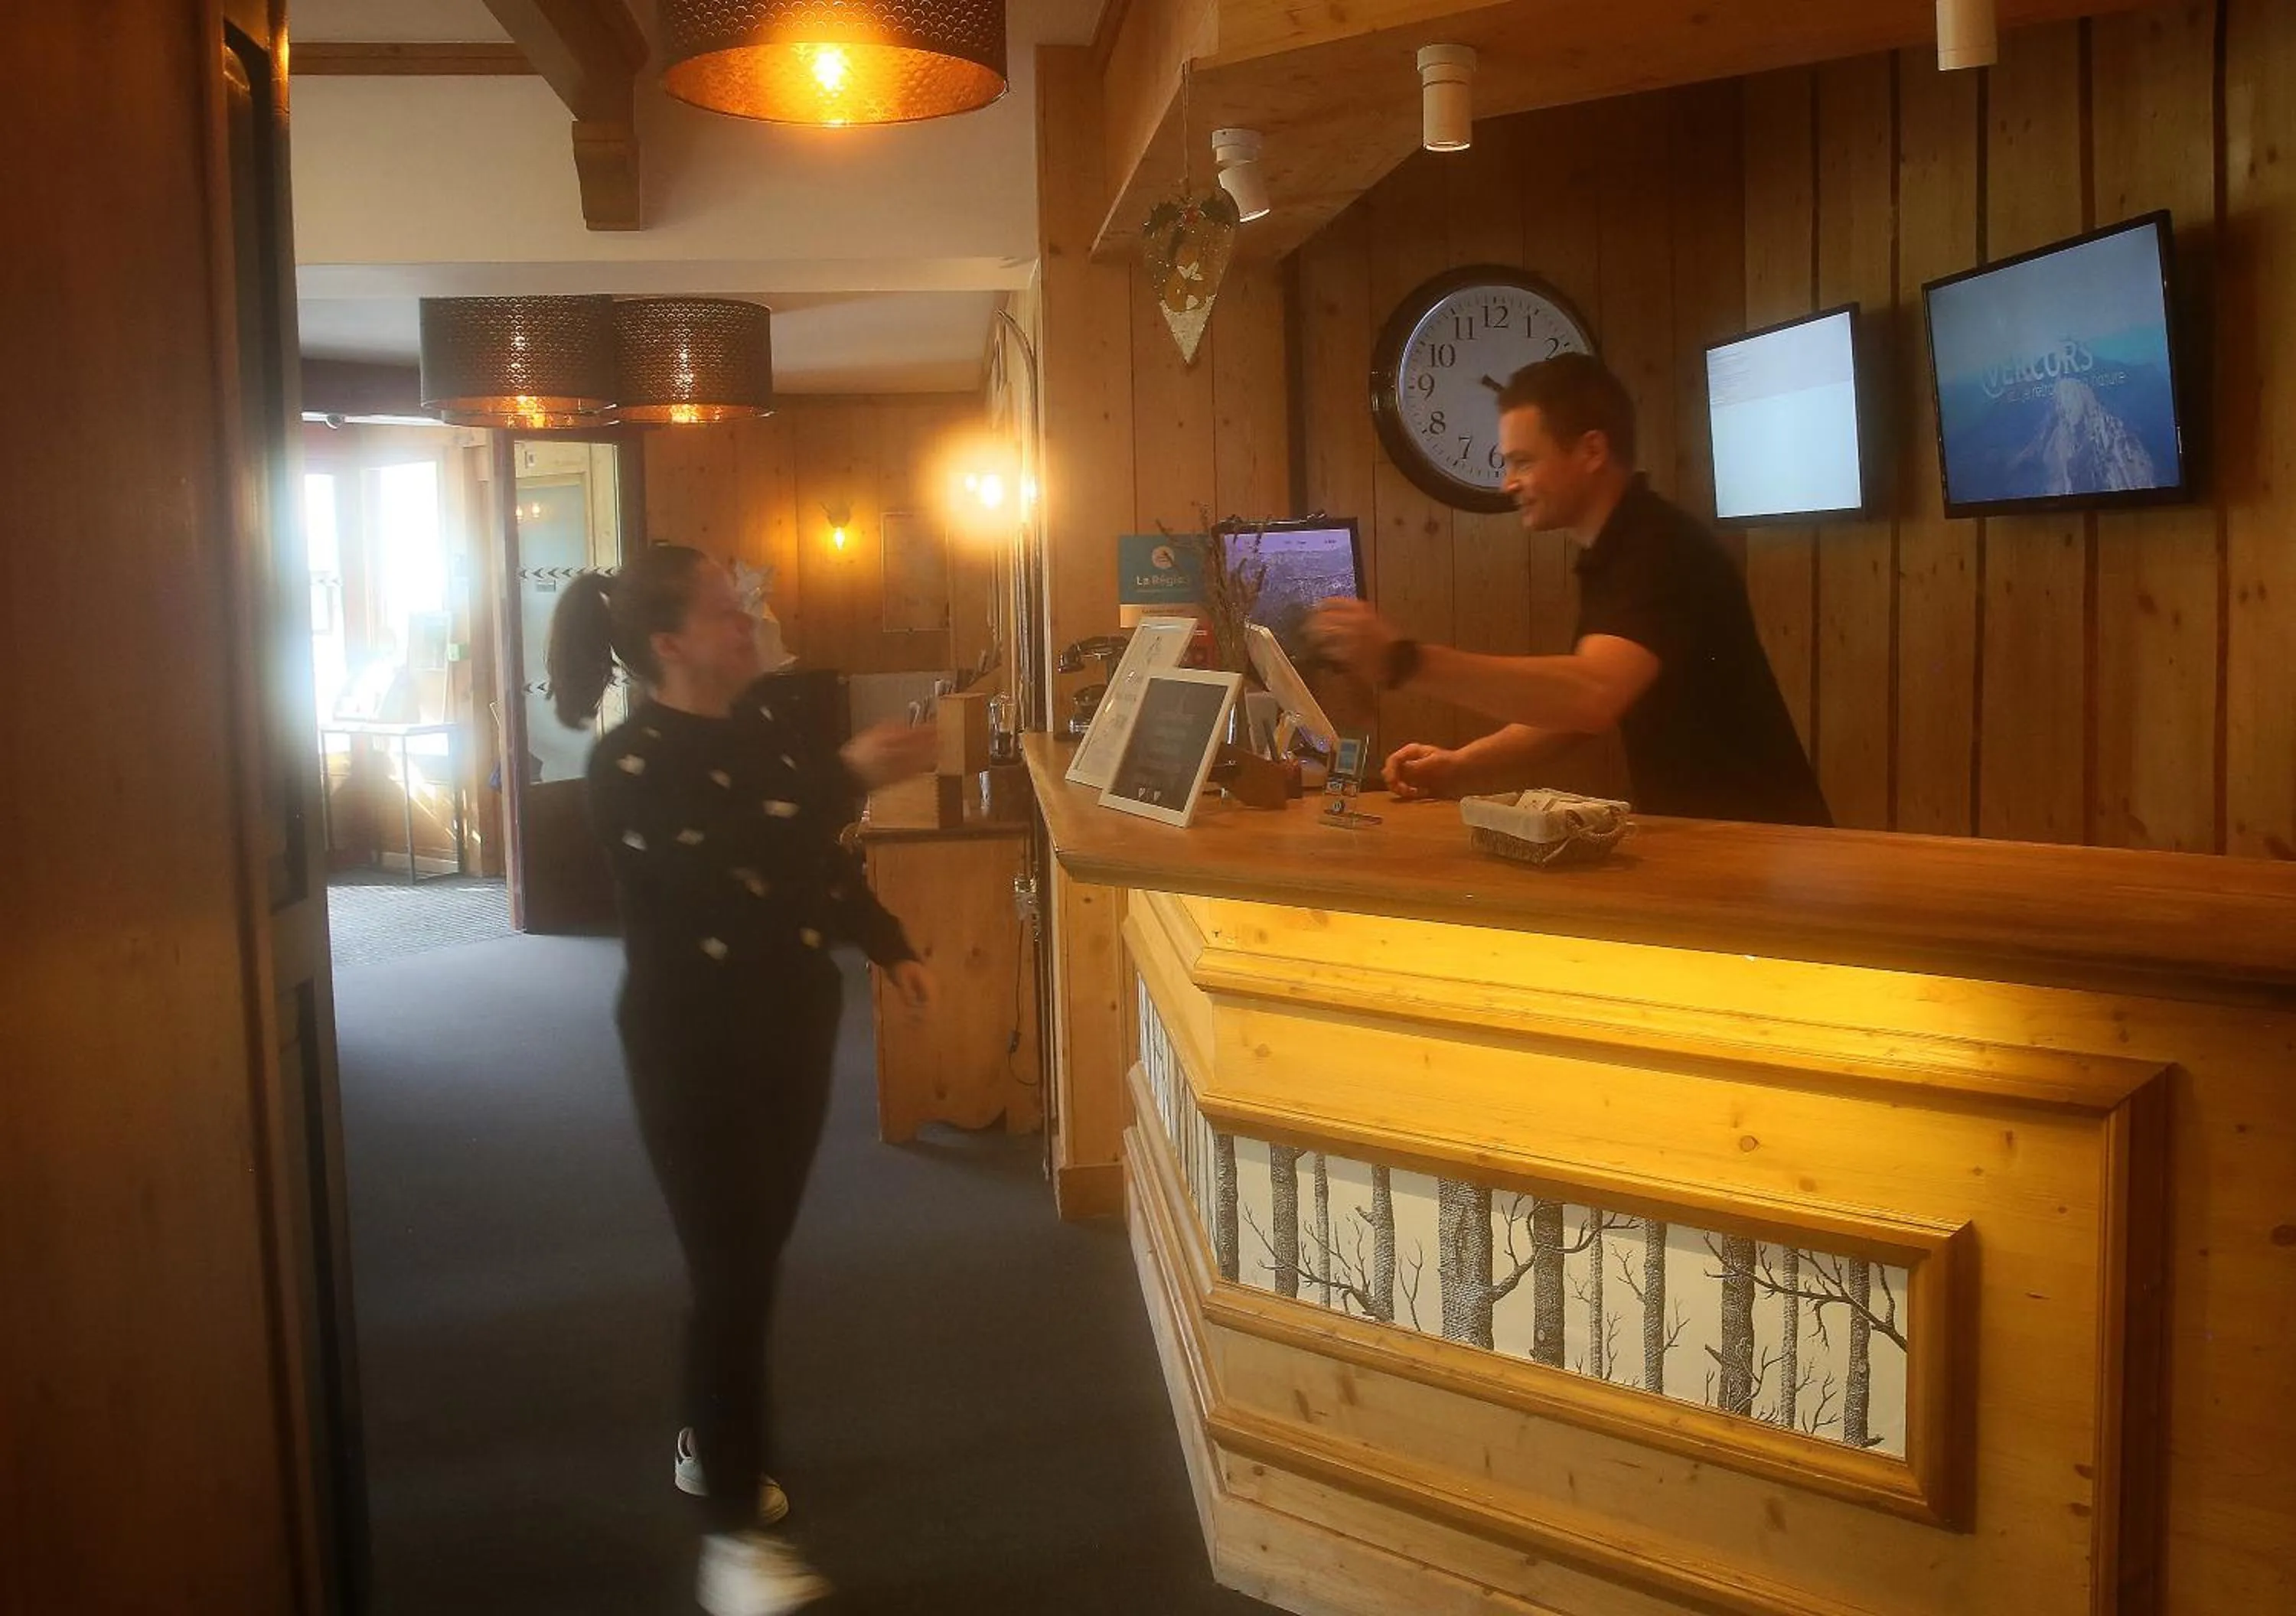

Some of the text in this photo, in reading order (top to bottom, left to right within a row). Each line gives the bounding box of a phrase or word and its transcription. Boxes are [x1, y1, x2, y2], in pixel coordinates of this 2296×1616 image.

[1455, 316, 1476, 340] 11
[1482, 305, 1508, 328] 12
[1525, 315, 1533, 338] 1
[1428, 344, 1456, 368] 10
[1544, 337, 1560, 360] 2
[1417, 373, 1435, 399] 9
[1428, 411, 1446, 435] 8
[1457, 435, 1473, 460] 7
[1489, 445, 1505, 469] 6
